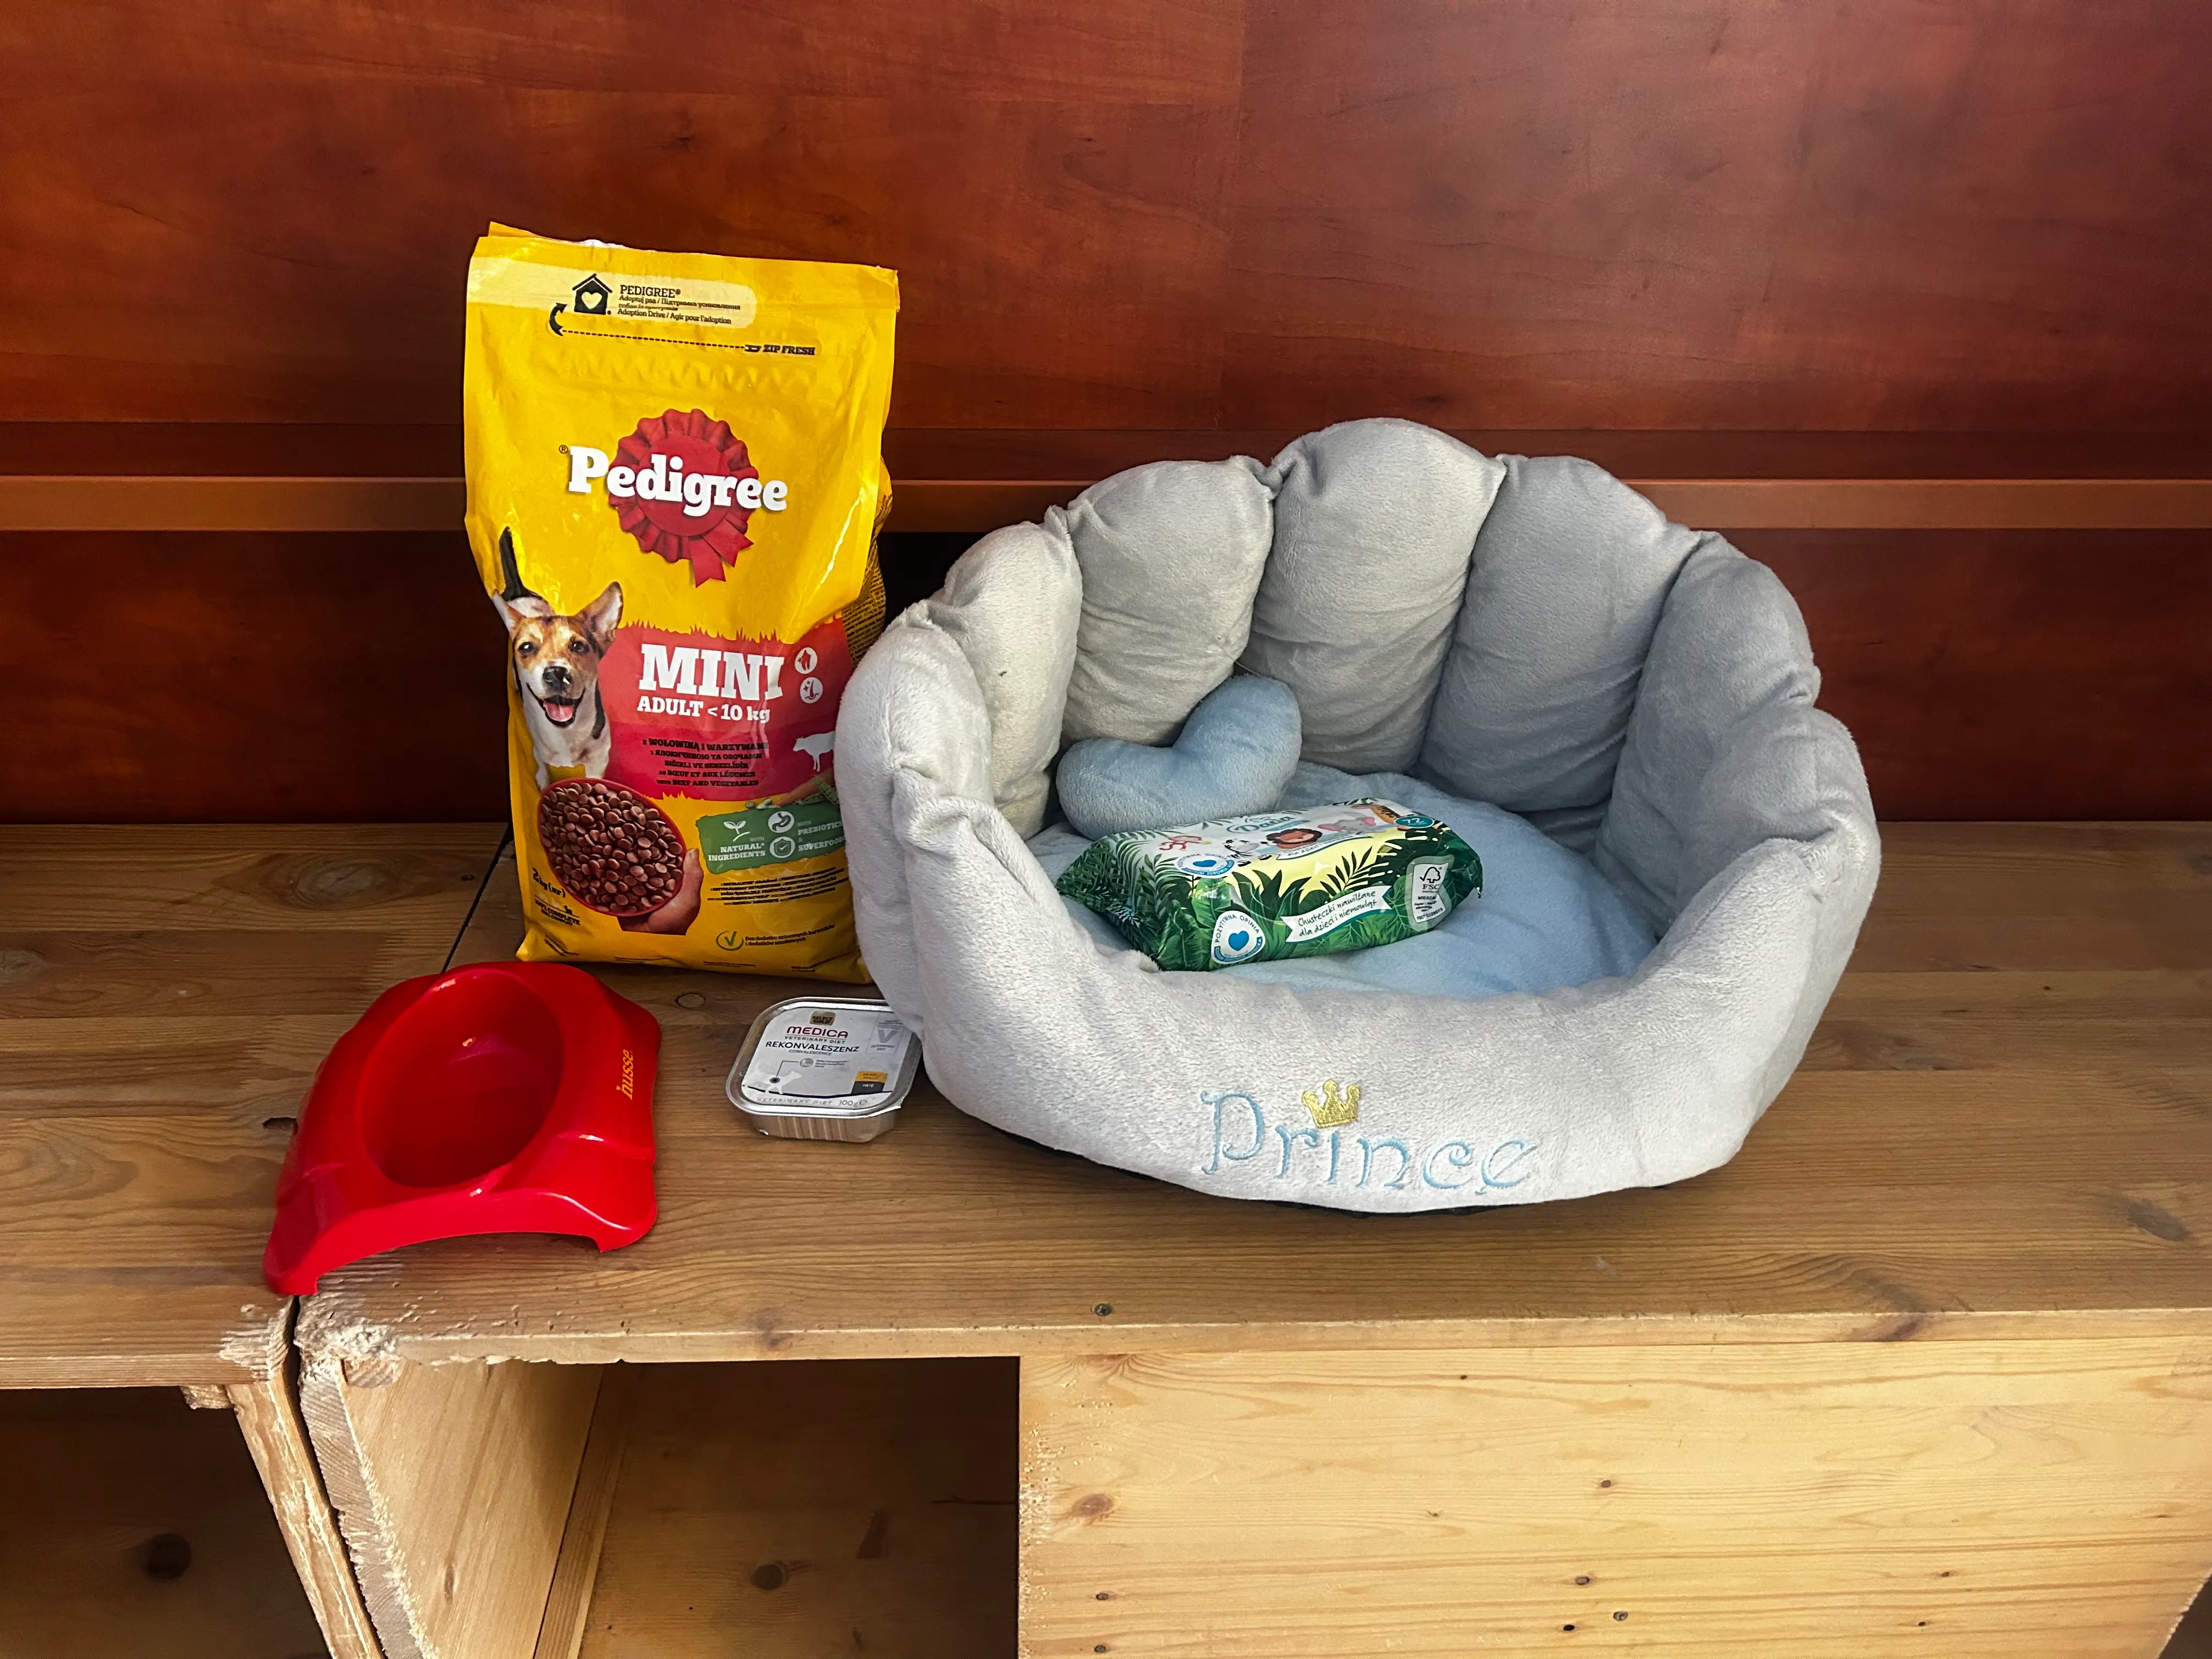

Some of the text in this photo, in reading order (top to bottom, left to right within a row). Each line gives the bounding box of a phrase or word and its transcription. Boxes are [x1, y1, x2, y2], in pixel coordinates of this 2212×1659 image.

[619, 295, 644, 305] Adoptuj
[617, 308, 647, 317] Adoption
[670, 313, 684, 321] Agir
[701, 316, 731, 324] l'adoption
[763, 344, 816, 356] ZIP FRESH
[568, 445, 788, 517] Pedigree
[639, 644, 785, 701] MINI
[637, 696, 770, 724] ADULT < 10 kg
[648, 738, 699, 752] WOŁOWINĄ
[798, 836, 845, 851] SUPERFOOD
[708, 850, 766, 861] INGREDIENTS
[1298, 890, 1376, 926] Chusteczki nawilżane
[1299, 899, 1377, 936] dla dzieci i niemowląt
[1215, 914, 1260, 943] POZYTYWNA OPINIA
[787, 1026, 848, 1038] MEDICA
[765, 1041, 860, 1052] REKONVALESZENZ
[1201, 1090, 1538, 1195] Prince
